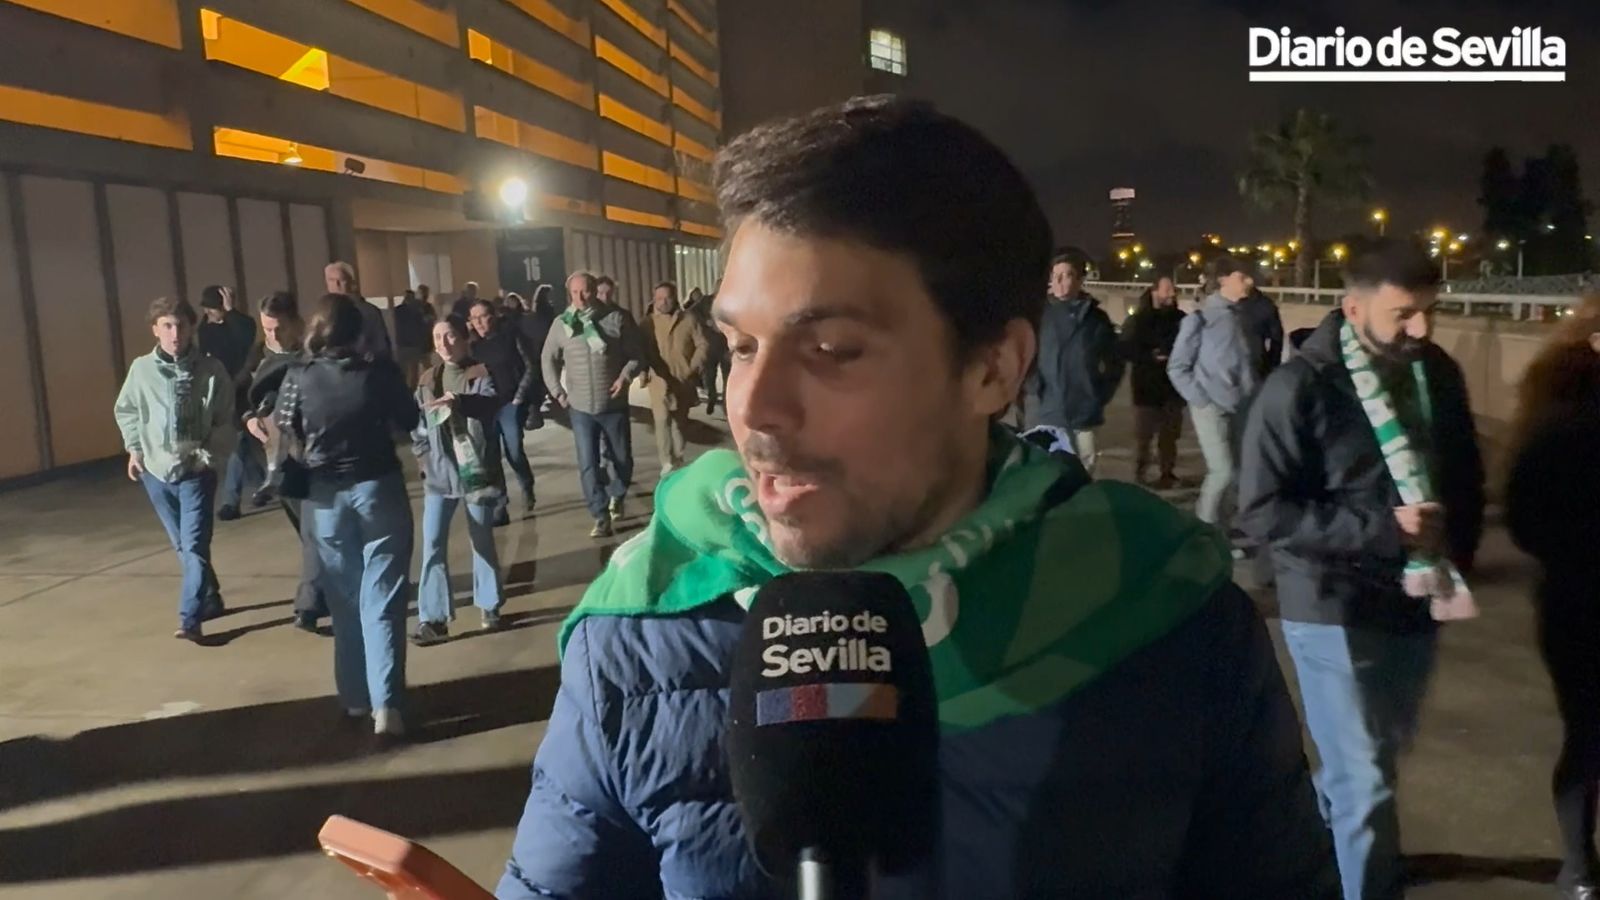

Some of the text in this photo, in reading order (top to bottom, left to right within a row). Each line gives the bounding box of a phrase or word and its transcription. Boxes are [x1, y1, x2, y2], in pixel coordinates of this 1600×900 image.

[523, 256, 541, 282] 16
[762, 610, 888, 640] Diario de
[761, 637, 892, 678] Sevilla
